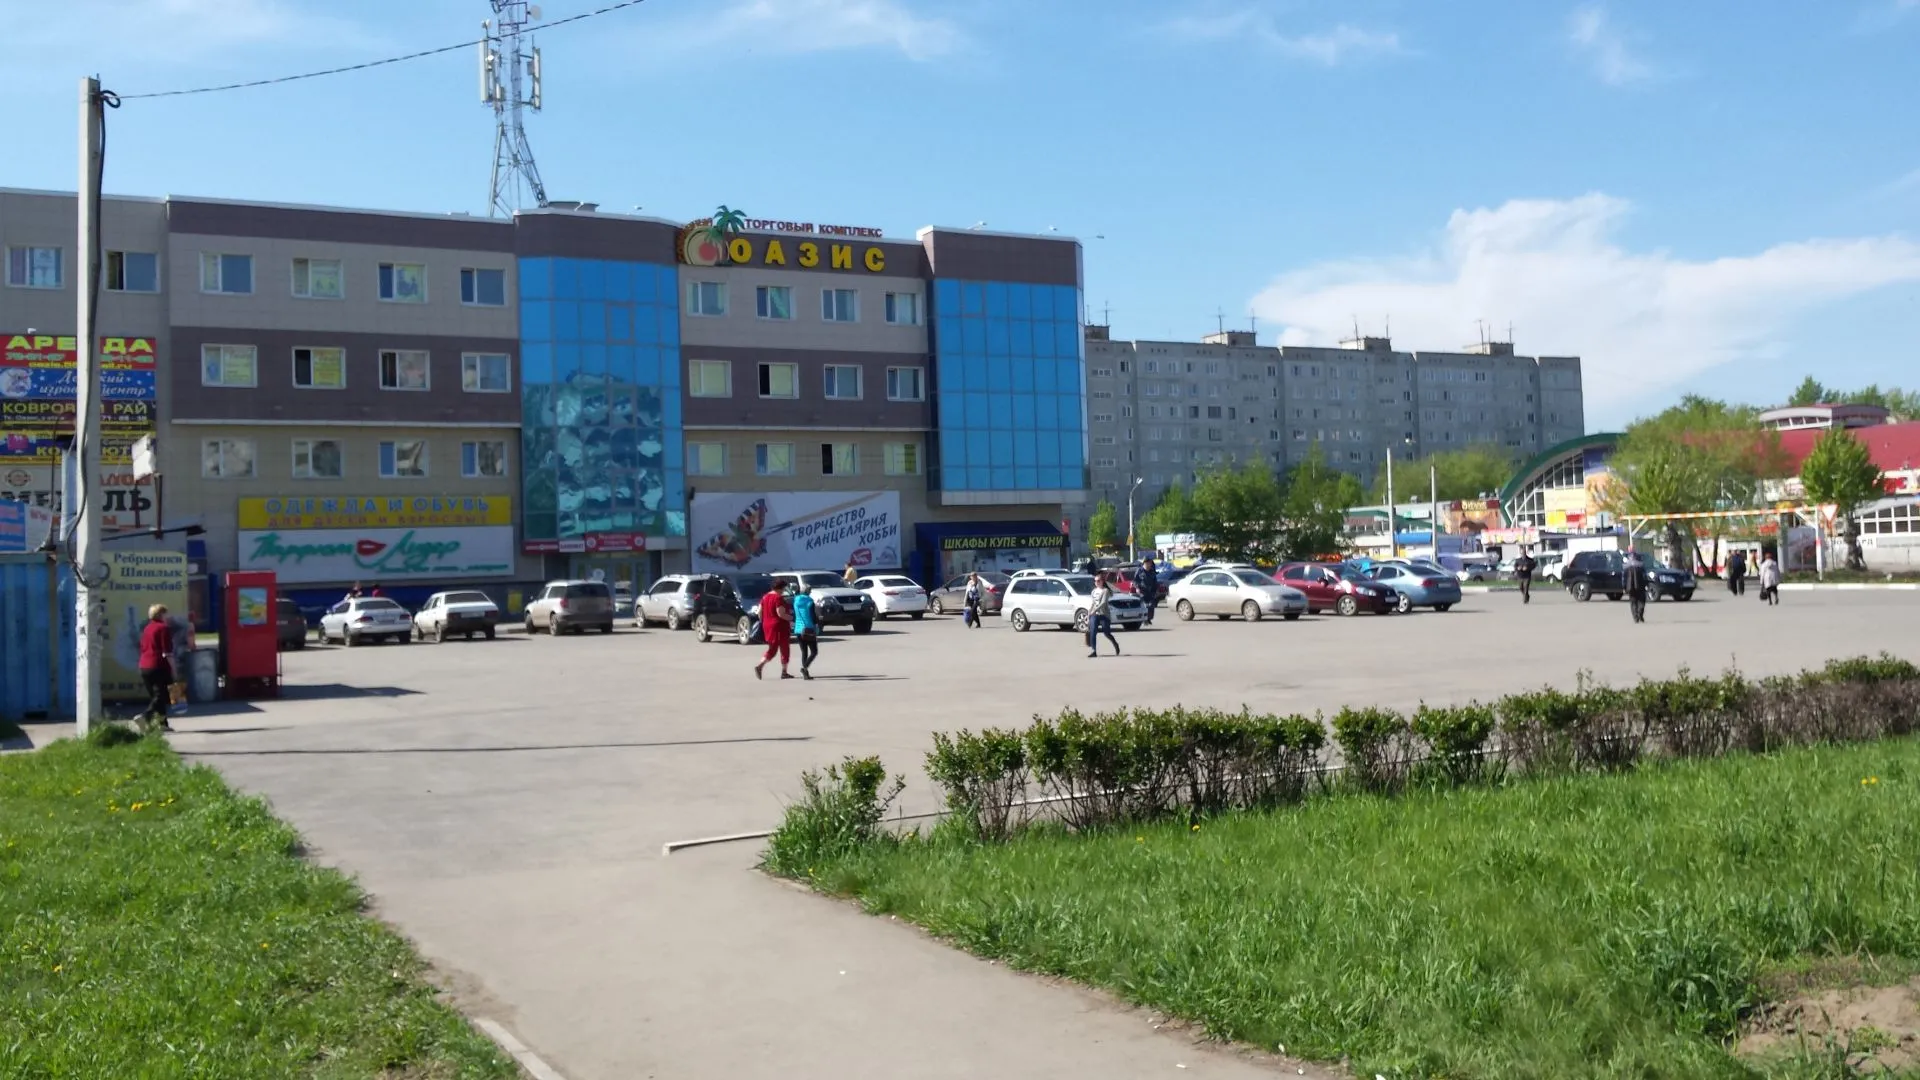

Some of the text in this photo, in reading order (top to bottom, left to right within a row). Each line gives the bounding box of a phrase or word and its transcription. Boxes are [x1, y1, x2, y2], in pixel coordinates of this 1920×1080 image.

[745, 218, 882, 238] ТОРГОВЫЙ КОМПЛЕКС
[728, 238, 886, 273] ОАЗИС
[6, 335, 153, 355] АРЕДА
[57, 370, 124, 383] Декий
[113, 401, 147, 415] РАЙ
[266, 497, 489, 515] ОДЕЖДА И ОБУВЬ
[790, 507, 866, 541] ТВОРЧЕСТВО
[806, 512, 888, 550] КАНЦЕЛЯРИЯ
[858, 523, 898, 546] ХОББИ
[943, 535, 1063, 549] ШКАФЫ КУПЕ КУХНИ
[113, 552, 183, 565] Ребрышки
